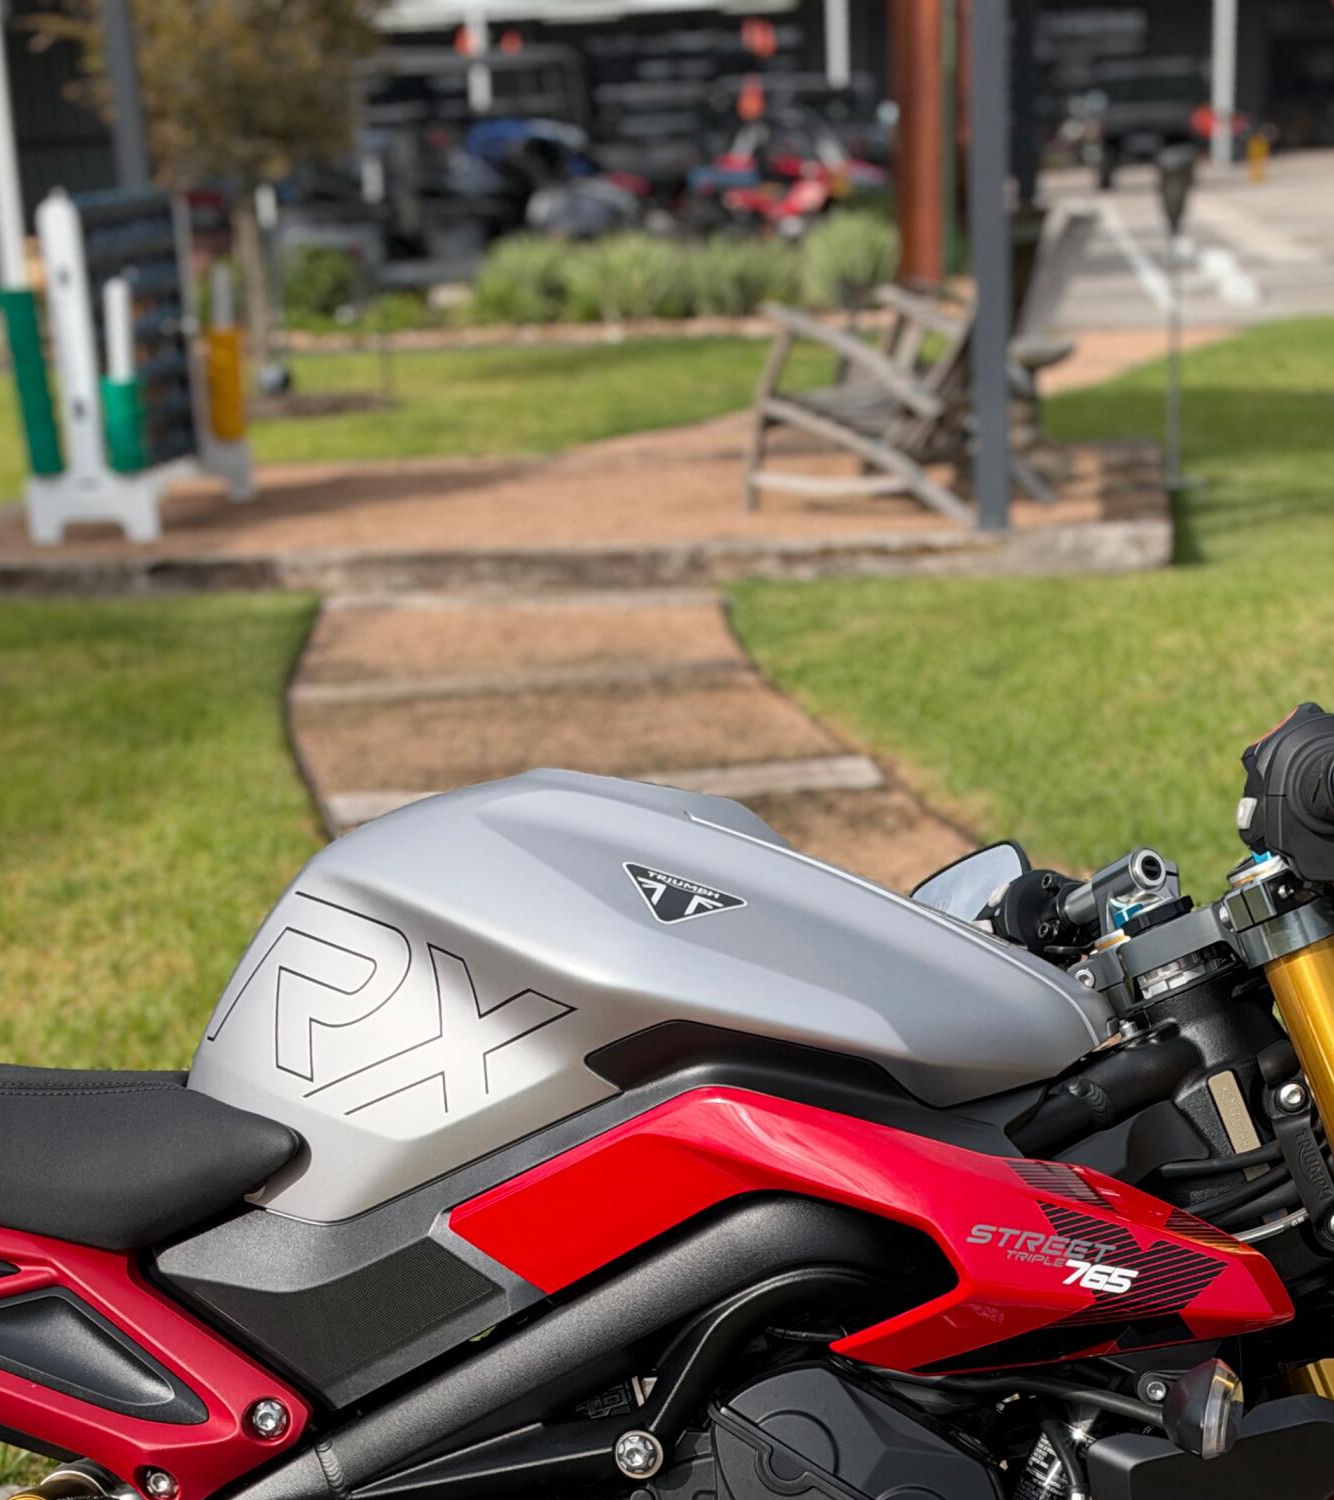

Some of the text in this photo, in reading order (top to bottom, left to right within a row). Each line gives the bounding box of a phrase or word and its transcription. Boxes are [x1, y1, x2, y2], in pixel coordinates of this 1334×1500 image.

[647, 871, 721, 899] TRIUMPH
[207, 891, 578, 1116] RX
[1294, 1127, 1334, 1200] TRIUMPH
[966, 1224, 1117, 1263] STREET
[1006, 1249, 1064, 1269] TRIPLE
[1062, 1259, 1139, 1294] 765
